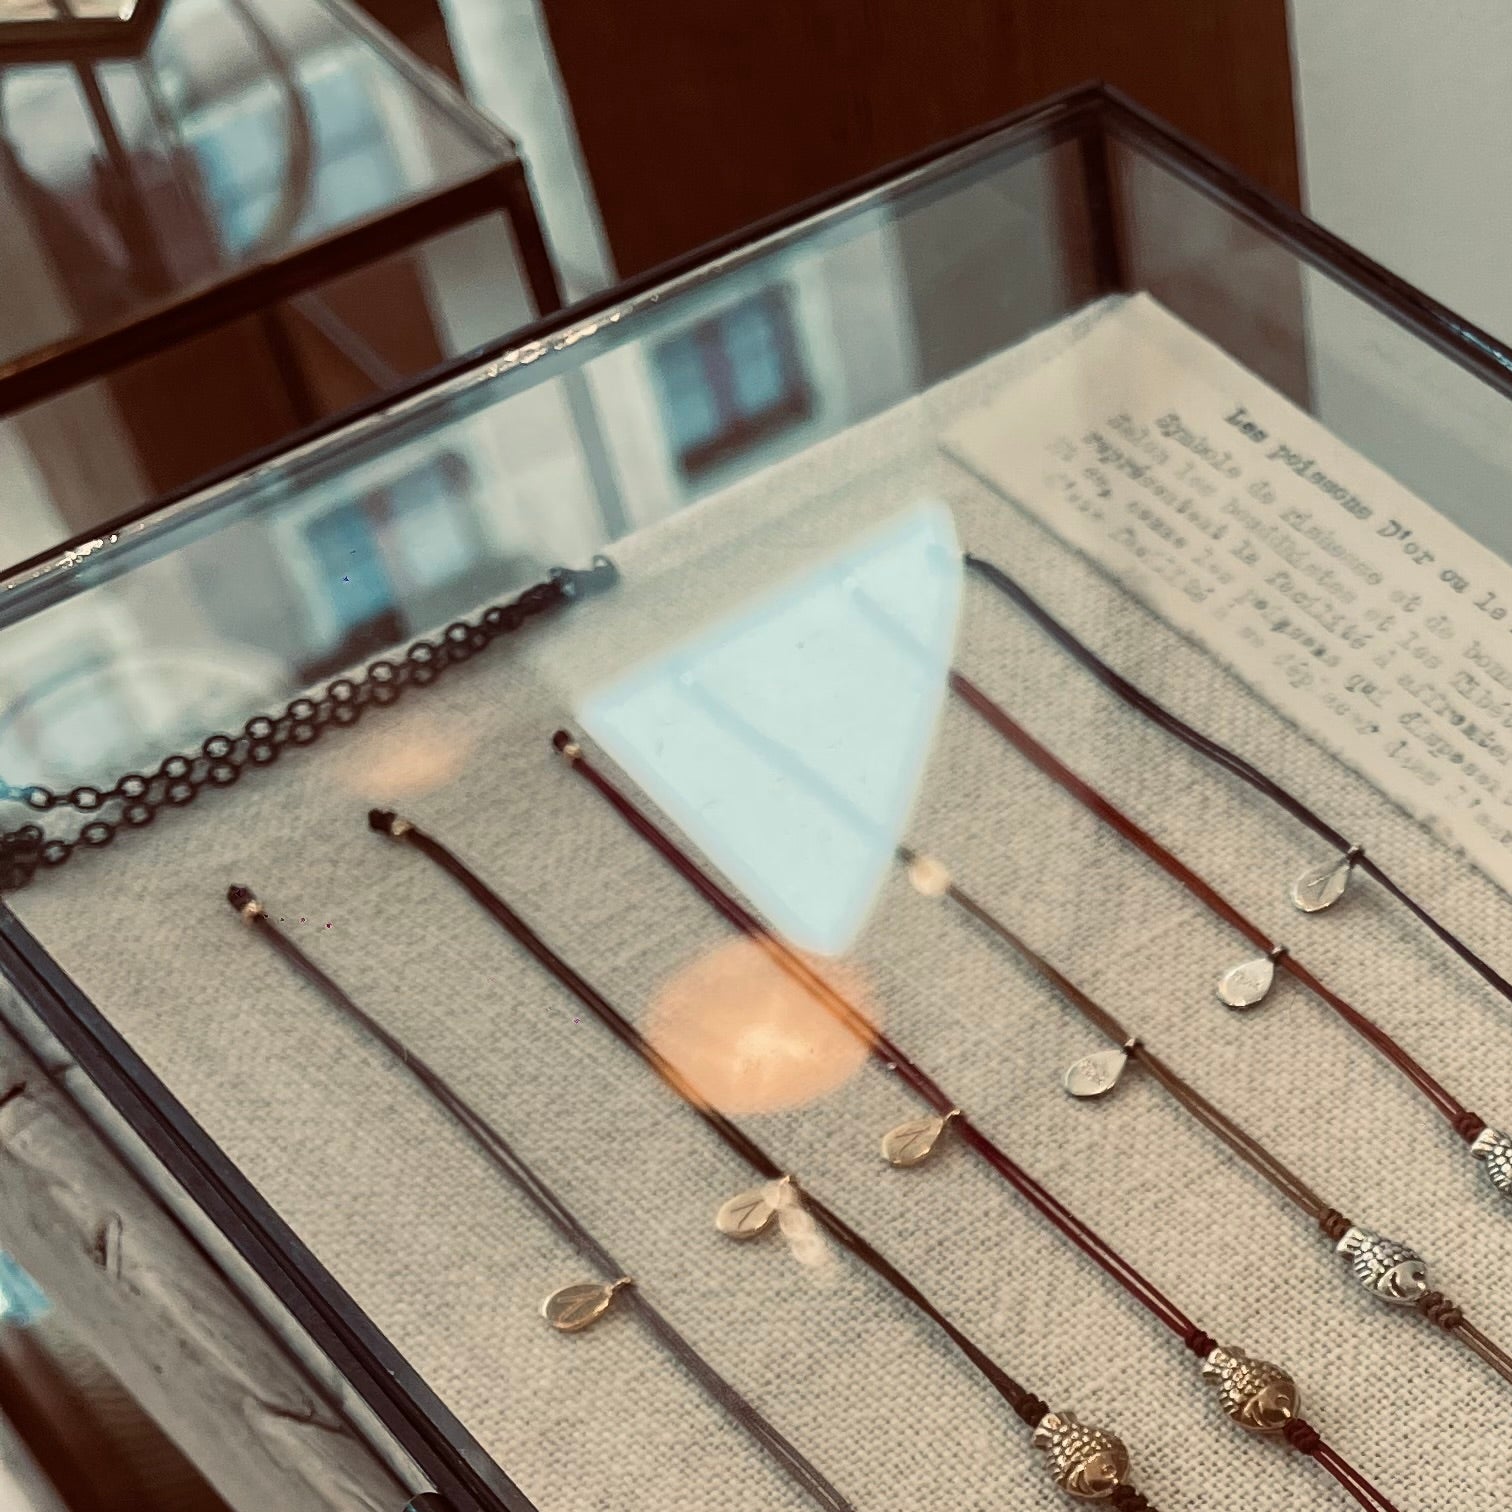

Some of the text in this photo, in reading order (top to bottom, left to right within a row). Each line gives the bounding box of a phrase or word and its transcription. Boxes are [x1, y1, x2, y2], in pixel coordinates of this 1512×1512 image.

[1154, 411, 1242, 479] Symbole
[1246, 479, 1276, 504] de
[1389, 589, 1422, 613] et
[1424, 613, 1455, 639] de
[1174, 461, 1217, 496] les
[1364, 608, 1395, 632] et
[1395, 630, 1443, 669] les
[1225, 407, 1267, 442] Les
[1266, 444, 1373, 519] poissons
[1377, 519, 1435, 565] D'or
[1439, 569, 1469, 592] ou
[1474, 592, 1508, 620] le
[1228, 538, 1260, 567] la
[1263, 570, 1374, 649] facilité
[1343, 673, 1391, 708] qui
